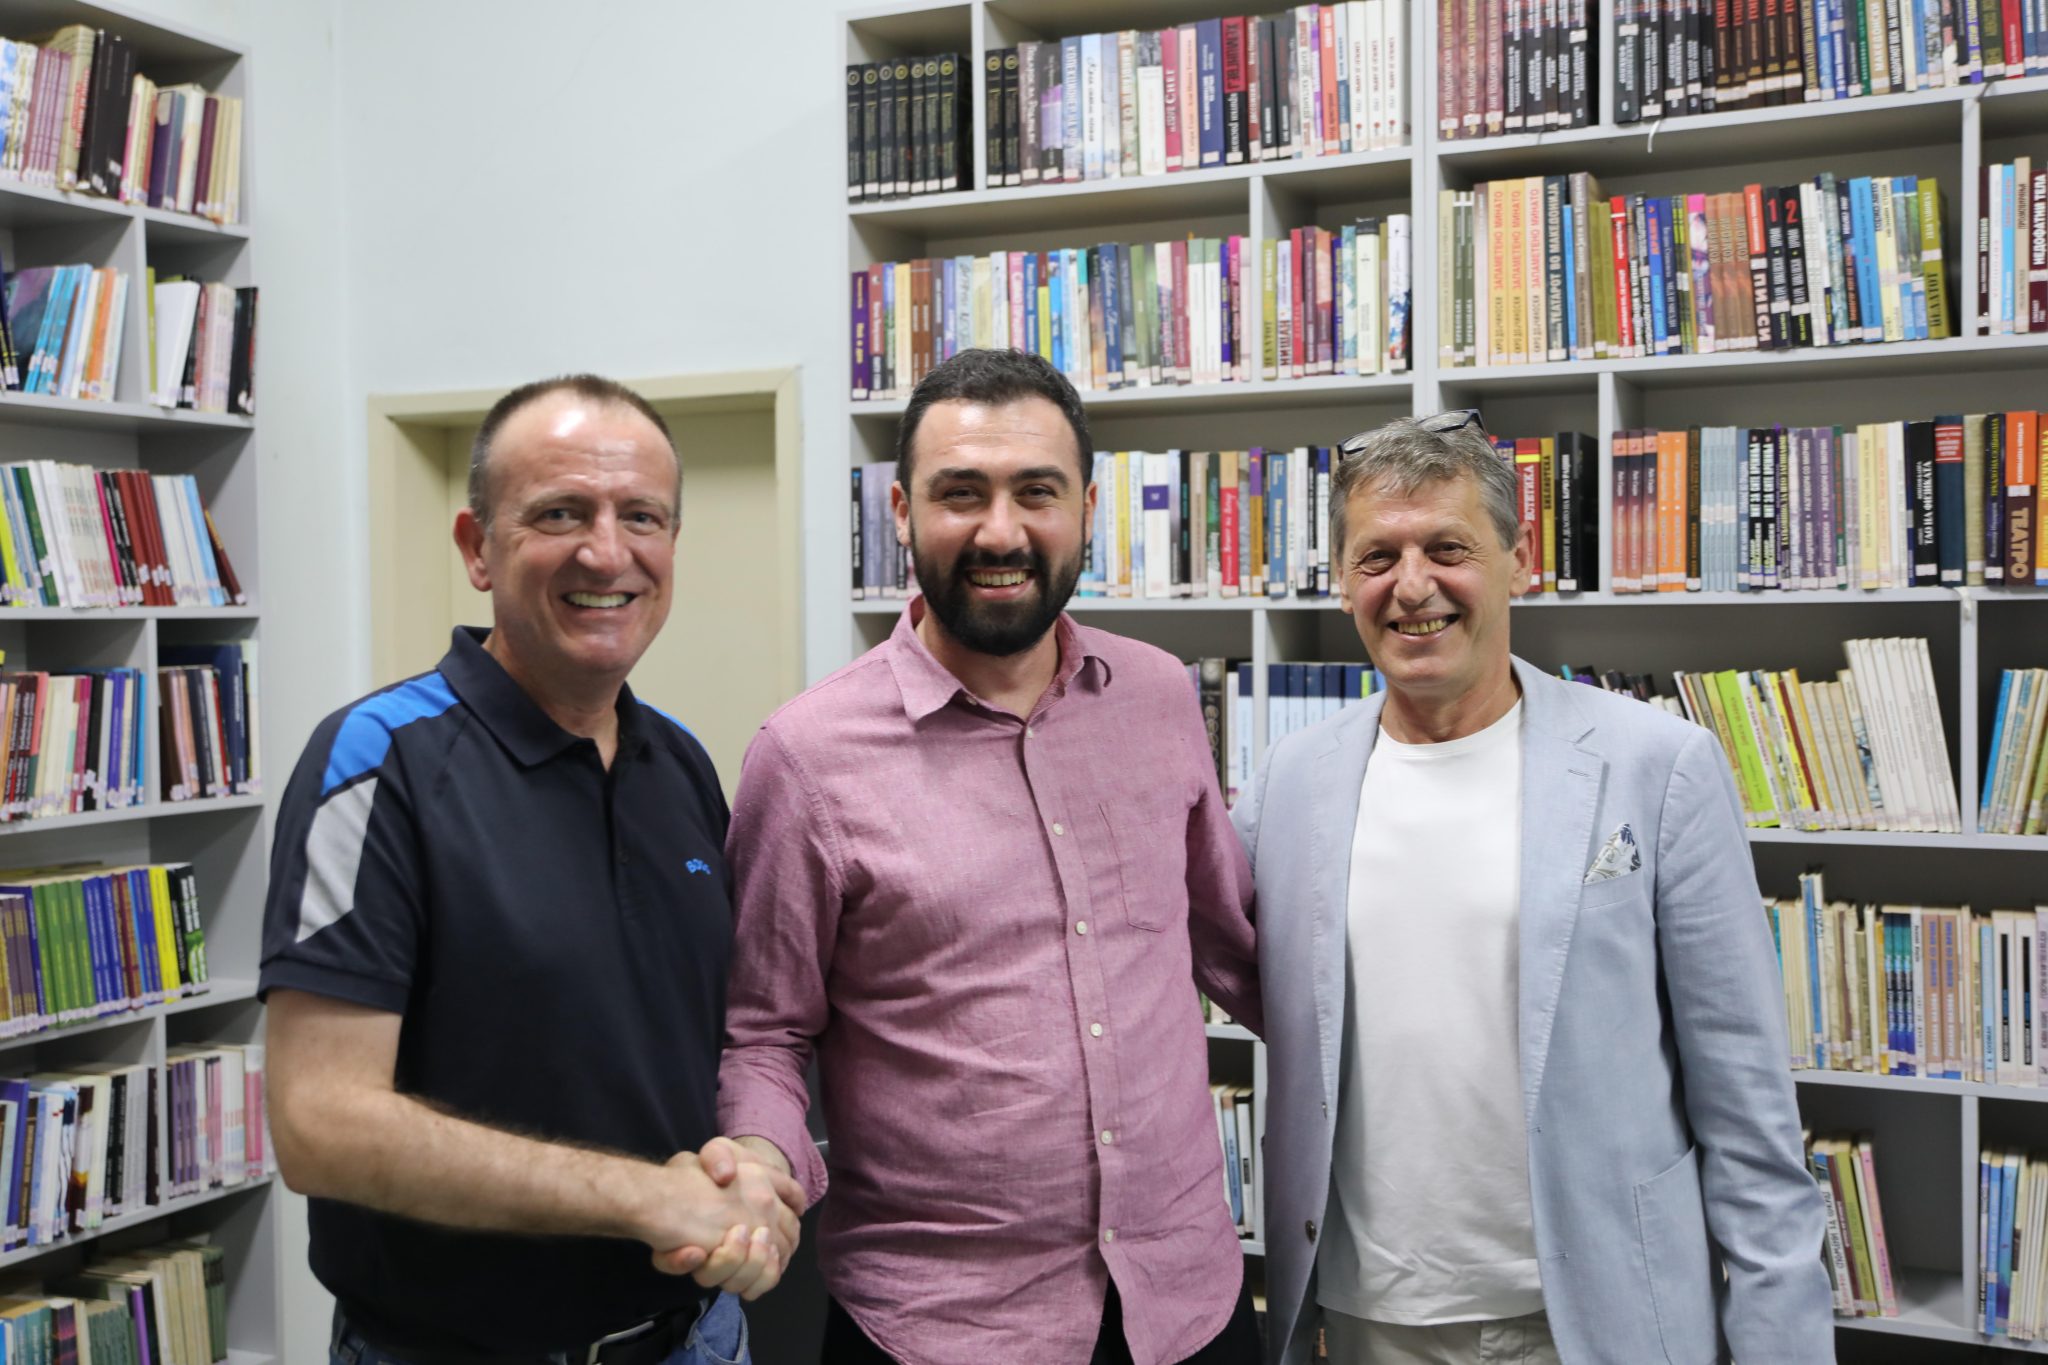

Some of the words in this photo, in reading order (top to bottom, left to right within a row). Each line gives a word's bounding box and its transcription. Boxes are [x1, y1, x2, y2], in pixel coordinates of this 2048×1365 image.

[1494, 191, 1502, 228] МИНАТО
[1512, 191, 1520, 228] МИНАТО
[1530, 189, 1539, 226] МИНАТО
[1785, 199, 1799, 224] 2
[2034, 175, 2046, 201] ТЕЛА
[1548, 183, 1560, 253] МАКЕДОНИЈА
[2034, 203, 2046, 265] НЕДОФАТНИ
[1494, 232, 1503, 290] ЗАПАМЕТЕНО
[1512, 231, 1521, 290] ЗАПАМЕТЕНО
[1531, 229, 1540, 288] ЗАПАМЕТЕНО
[1550, 256, 1561, 270] ВО
[1550, 274, 1562, 323] ТЕАТАРОТ
[1755, 273, 1771, 342] ПИЕСИ
[1523, 464, 1535, 521] ЕСТЕТИКА
[1543, 455, 1551, 510] БИБЛИОТЕКА
[1803, 466, 1810, 474] СО
[1821, 465, 1828, 474] СО
[1923, 460, 1933, 510] ФИЗИКАТА
[1924, 511, 1933, 525] НА
[1924, 526, 1933, 545] ТАО
[2011, 507, 2029, 578] ТЕАТРО
